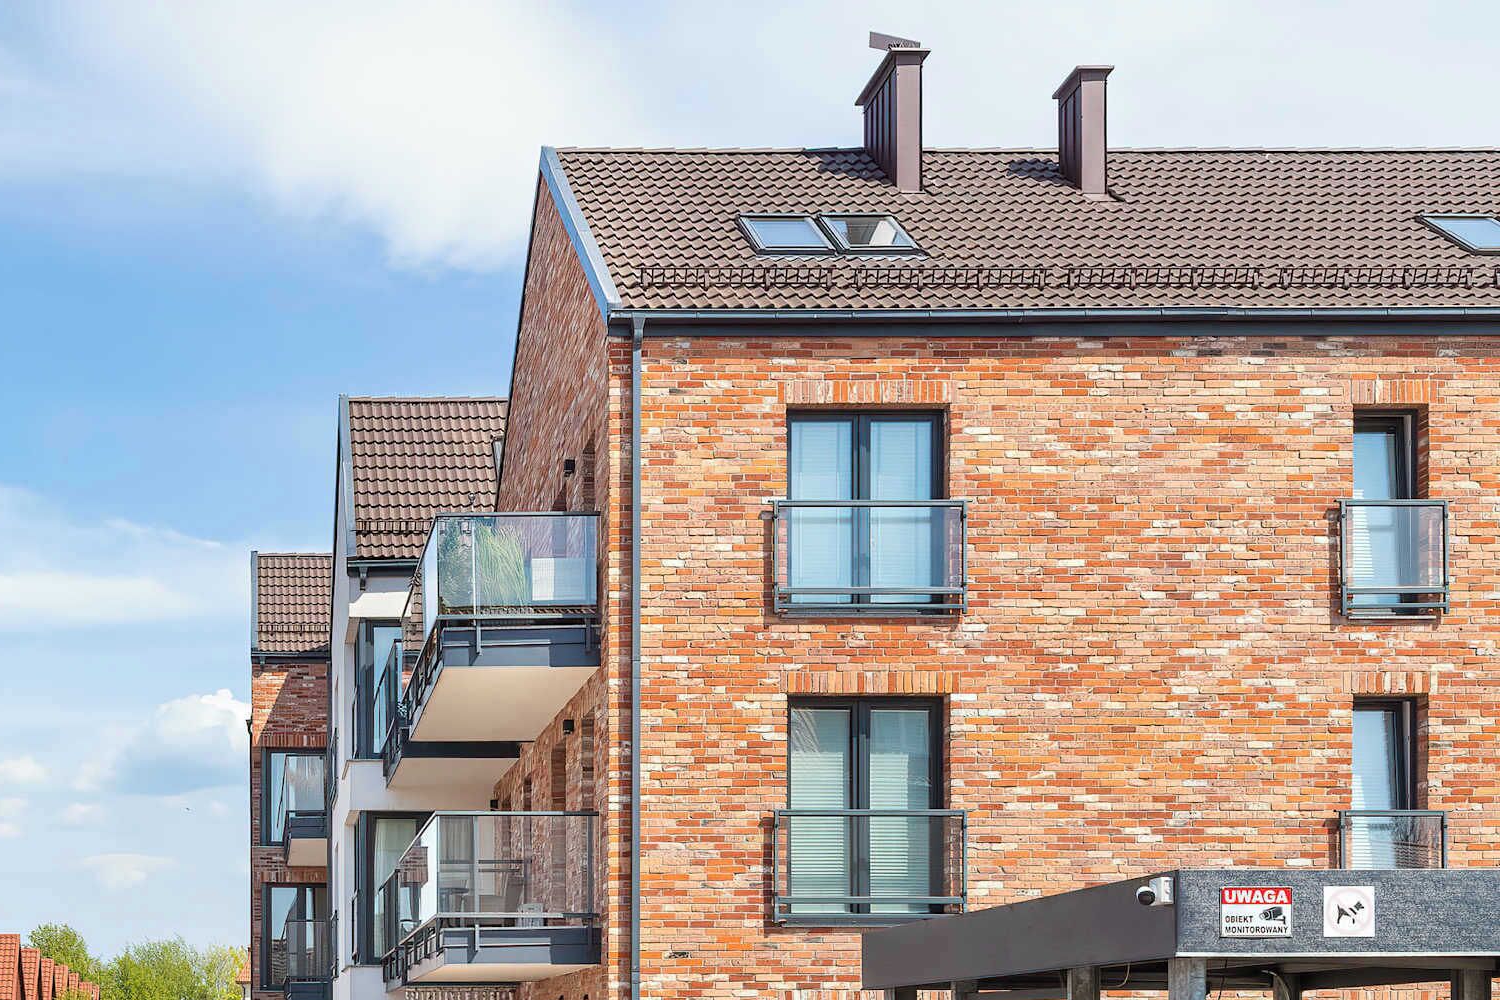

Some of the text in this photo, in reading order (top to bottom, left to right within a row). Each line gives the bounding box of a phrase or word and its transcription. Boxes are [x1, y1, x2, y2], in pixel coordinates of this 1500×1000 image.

[1224, 890, 1288, 903] UWAGA
[1225, 915, 1253, 923] OBIEKT
[1225, 926, 1288, 934] MONITOROWANY
